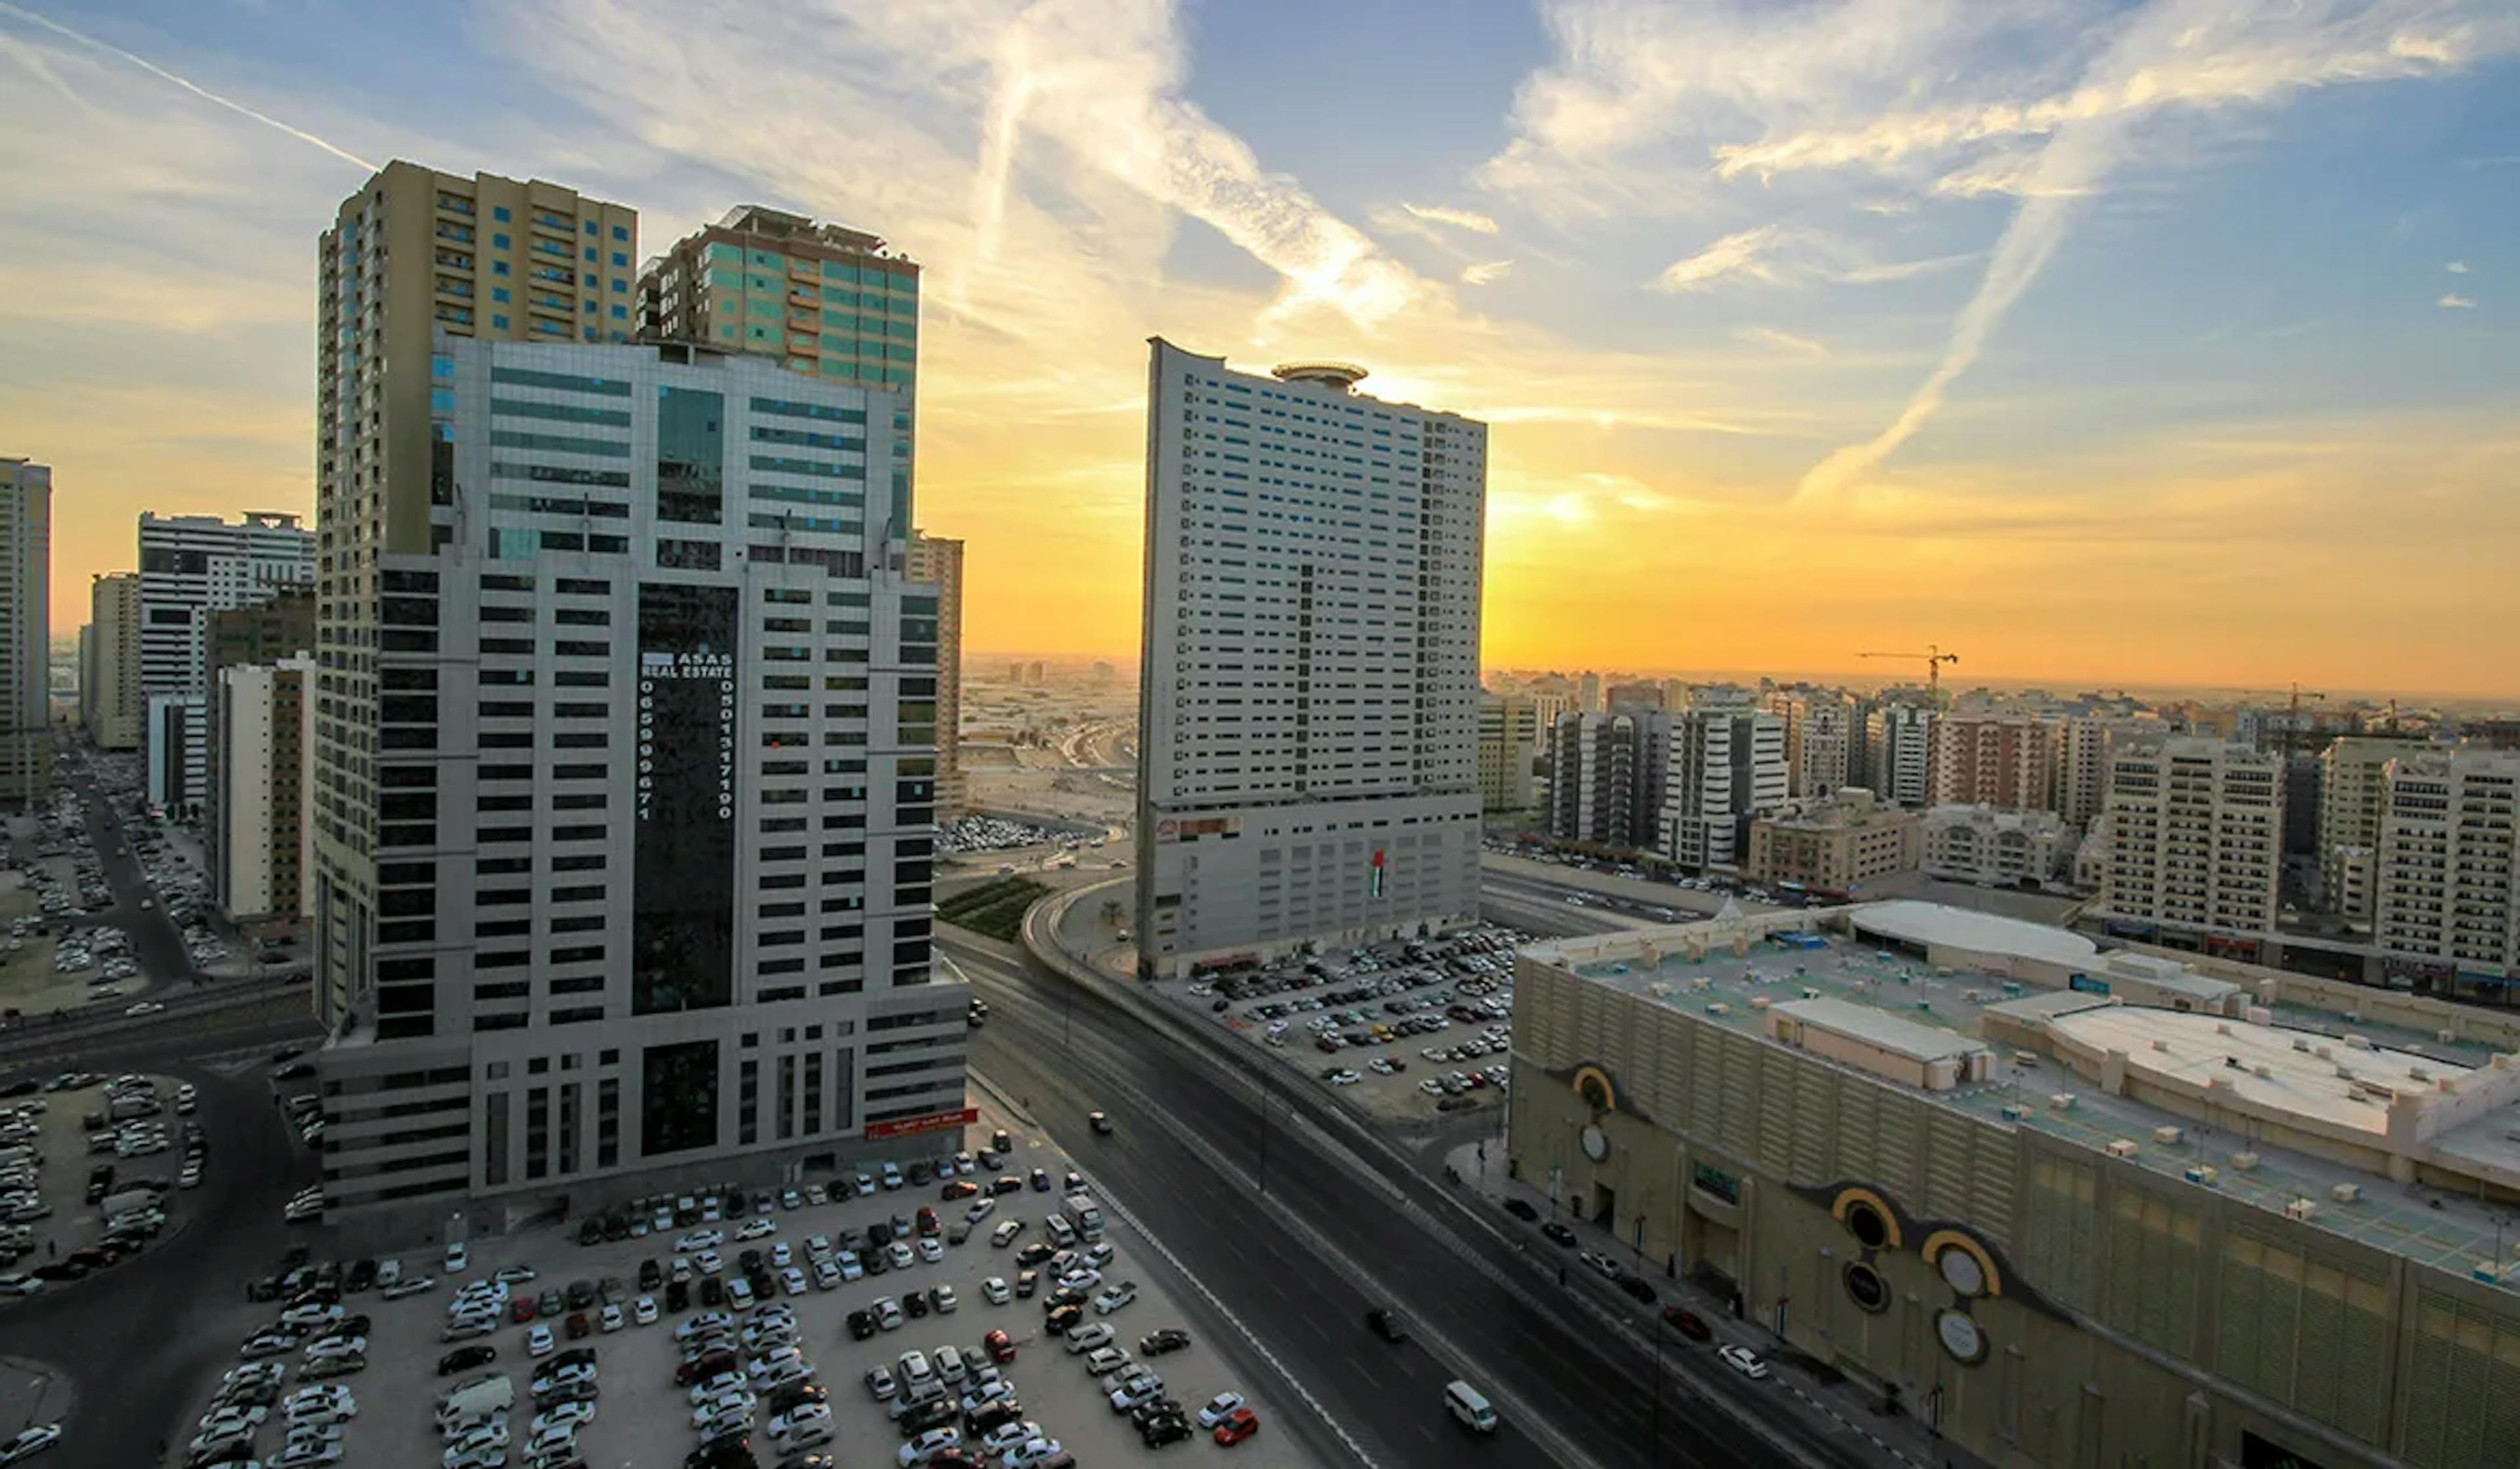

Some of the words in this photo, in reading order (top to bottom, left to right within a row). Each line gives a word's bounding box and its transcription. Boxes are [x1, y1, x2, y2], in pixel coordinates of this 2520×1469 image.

[679, 652, 732, 665] ASAS
[642, 665, 678, 678] REAL
[682, 665, 732, 678] ESTATE
